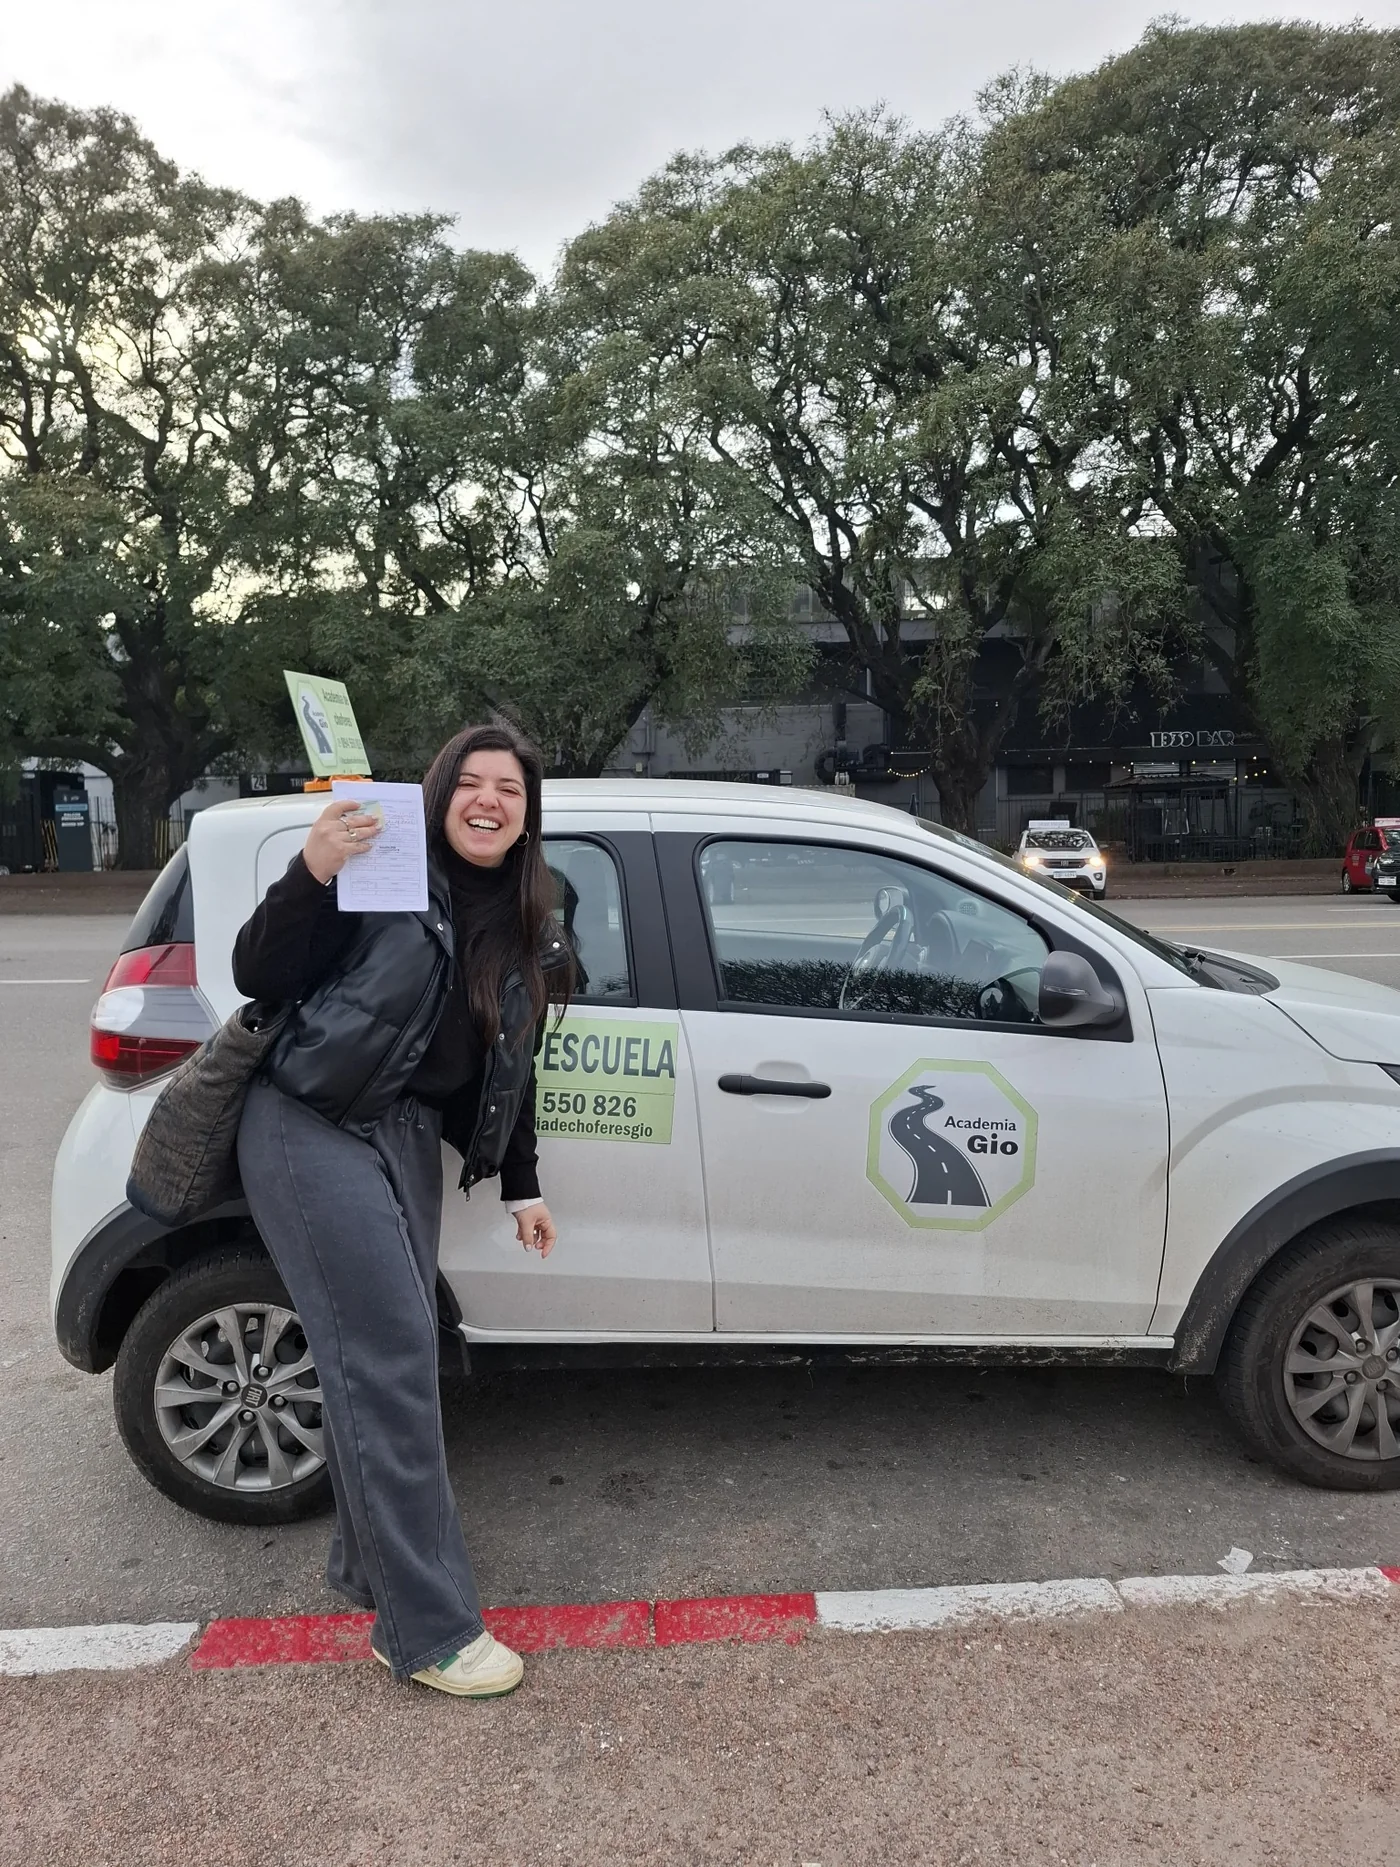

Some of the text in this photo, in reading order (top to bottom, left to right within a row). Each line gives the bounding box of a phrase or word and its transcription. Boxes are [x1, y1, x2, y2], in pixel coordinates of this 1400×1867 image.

[1197, 730, 1235, 747] BAR
[543, 1032, 676, 1079] ESCUELA
[542, 1091, 637, 1118] 550 826
[536, 1116, 653, 1140] iadechoferesgio
[944, 1115, 1017, 1131] Academia
[967, 1132, 1019, 1156] Gio
[245, 1386, 263, 1406] FIAT
